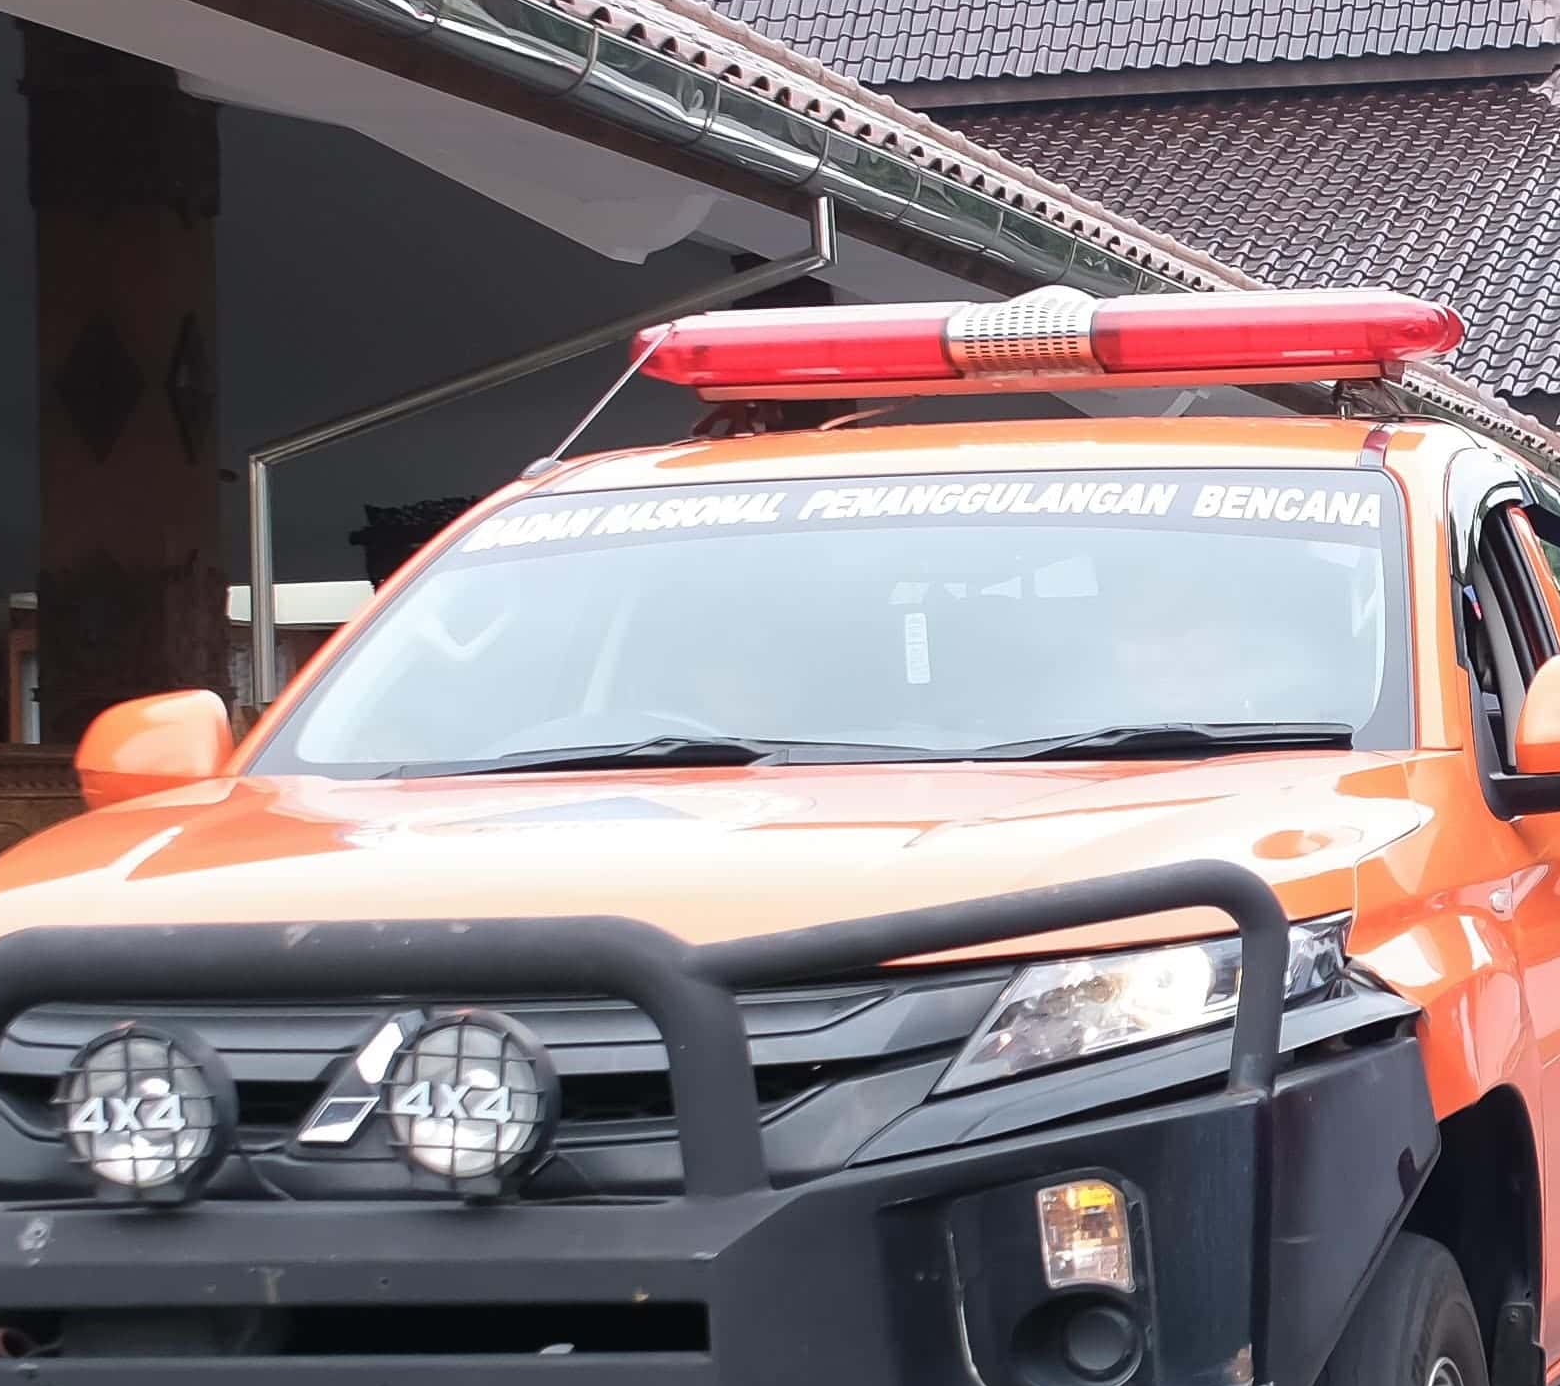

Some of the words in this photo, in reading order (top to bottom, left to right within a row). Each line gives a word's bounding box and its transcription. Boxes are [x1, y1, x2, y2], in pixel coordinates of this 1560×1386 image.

[462, 507, 602, 553] BADAN
[592, 492, 788, 536] NASIONAL
[798, 482, 1179, 521] PENANGGULANGAN
[1191, 484, 1381, 529] BENCANA
